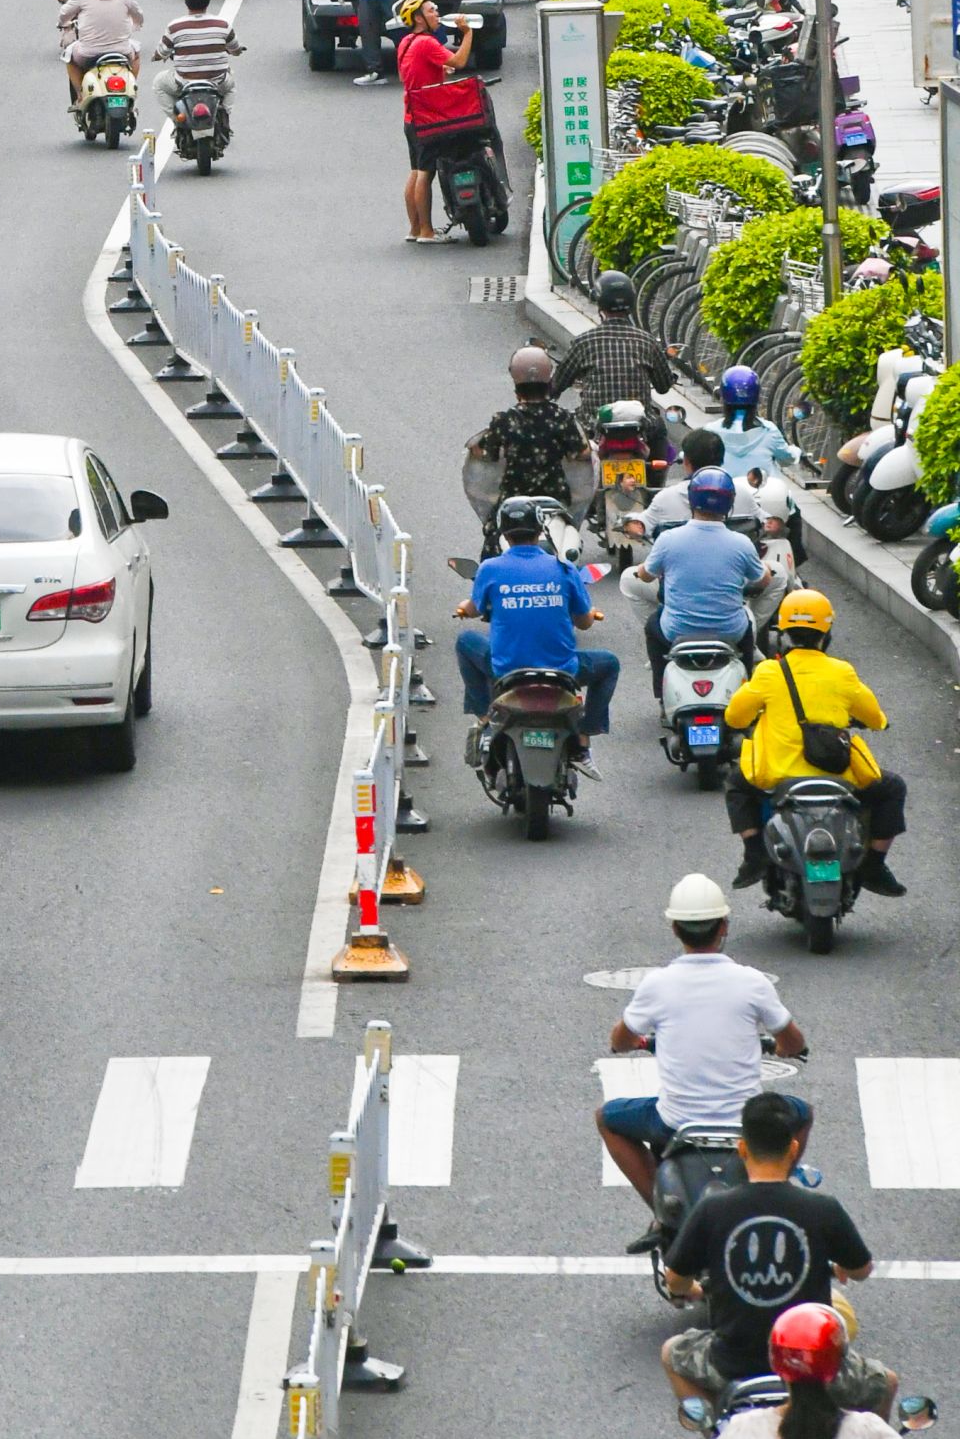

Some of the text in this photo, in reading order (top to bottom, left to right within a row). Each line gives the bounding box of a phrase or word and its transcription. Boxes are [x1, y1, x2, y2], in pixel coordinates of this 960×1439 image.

[511, 583, 545, 594] GREE
[501, 594, 564, 610] 格力空调
